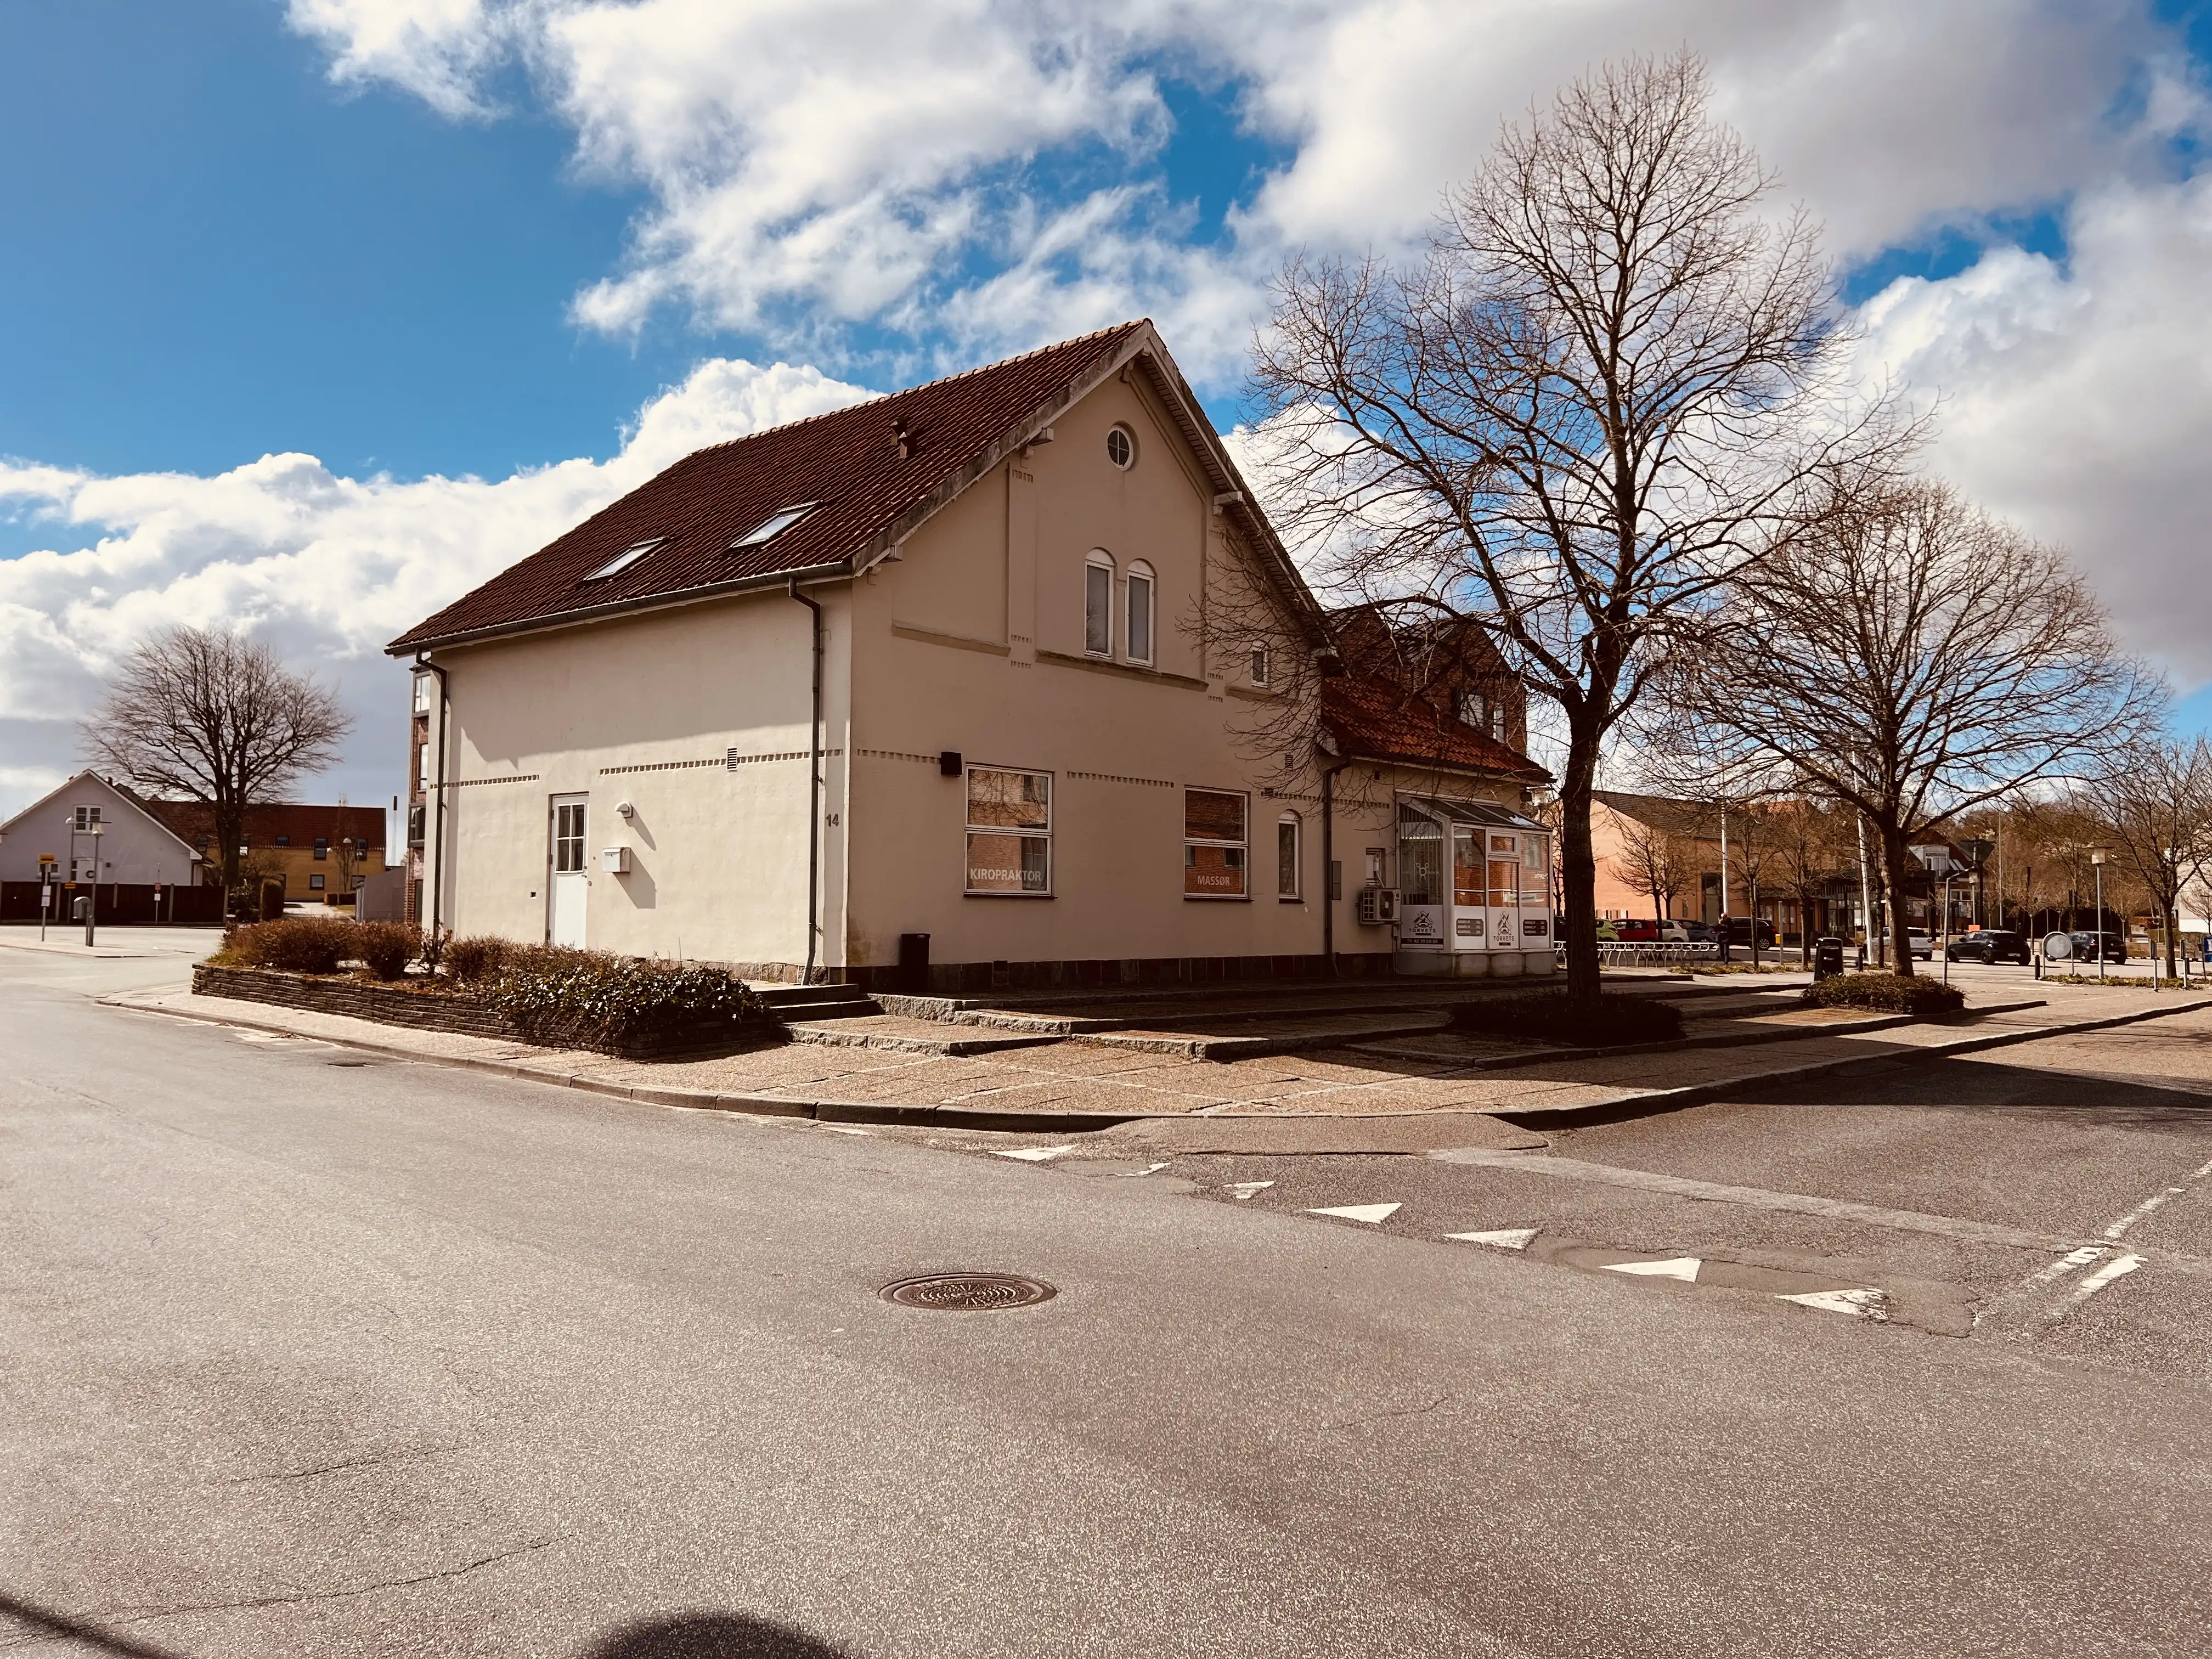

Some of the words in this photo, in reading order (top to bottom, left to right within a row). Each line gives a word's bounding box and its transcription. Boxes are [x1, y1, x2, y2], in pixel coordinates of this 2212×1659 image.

[826, 813, 839, 827] 14
[970, 868, 1041, 882] KIROPRAKTOR
[1197, 875, 1230, 886] MASSØR
